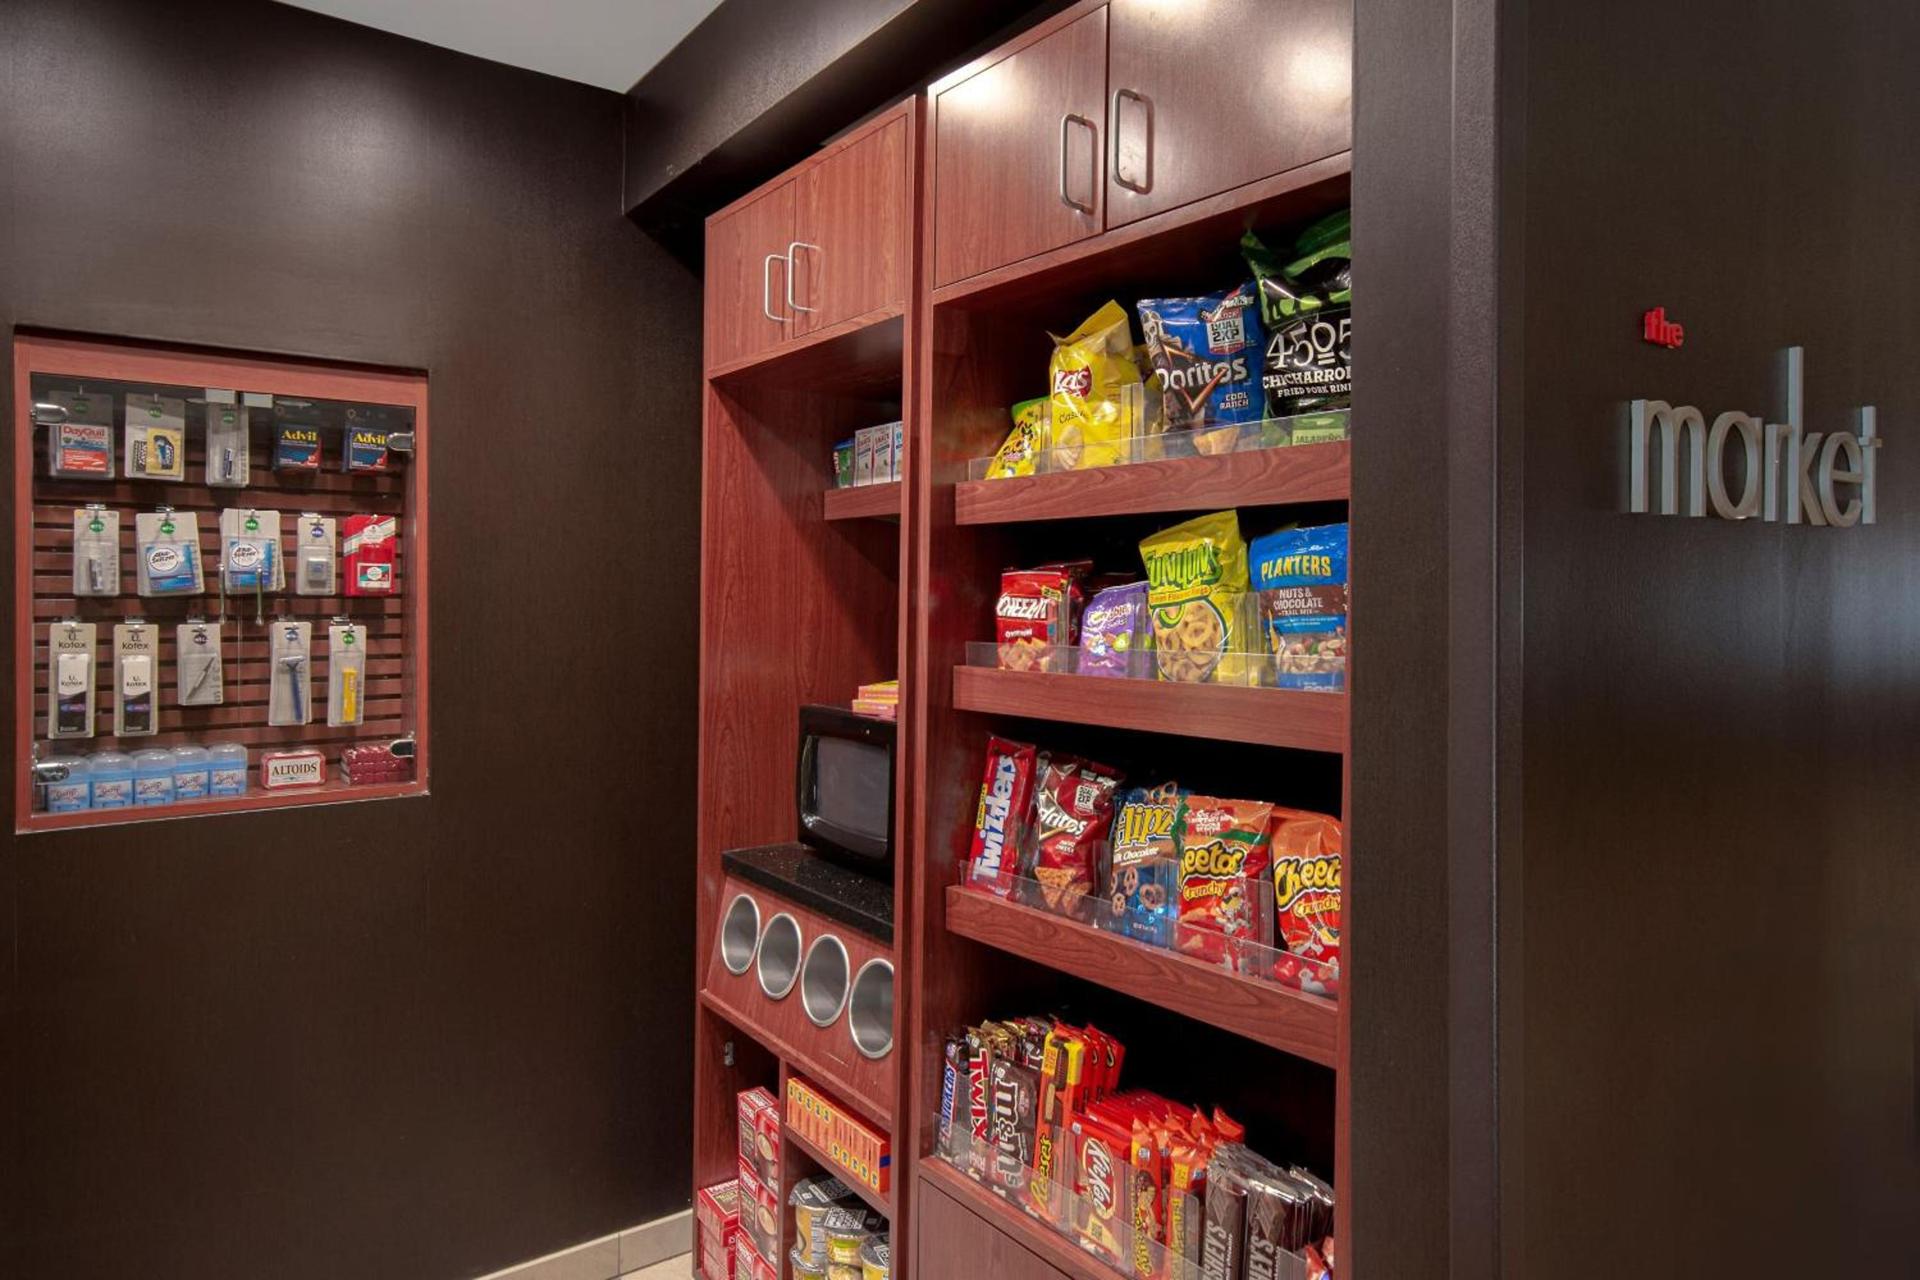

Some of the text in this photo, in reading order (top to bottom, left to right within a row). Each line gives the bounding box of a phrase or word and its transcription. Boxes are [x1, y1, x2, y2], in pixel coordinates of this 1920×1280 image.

[1644, 307, 1683, 347] the
[1212, 329, 1239, 342] 2XP
[1267, 319, 1351, 369] 4505
[1156, 358, 1247, 391] Doritos
[1226, 392, 1248, 401] COOL
[1278, 386, 1305, 398] FRIED
[1306, 385, 1329, 395] PORK
[1220, 399, 1248, 409] RANCH
[281, 430, 318, 442] Advil
[353, 432, 387, 445] Advil
[1630, 346, 1882, 527] market
[1261, 555, 1332, 582] PLANTERS
[1279, 587, 1312, 599] NUTS &
[1273, 598, 1324, 610] CHOCOLATE
[272, 763, 318, 775] ALTOIDS
[1181, 841, 1245, 878] eetos
[1183, 881, 1228, 900] Crunchy
[969, 1048, 989, 1144] TWIX
